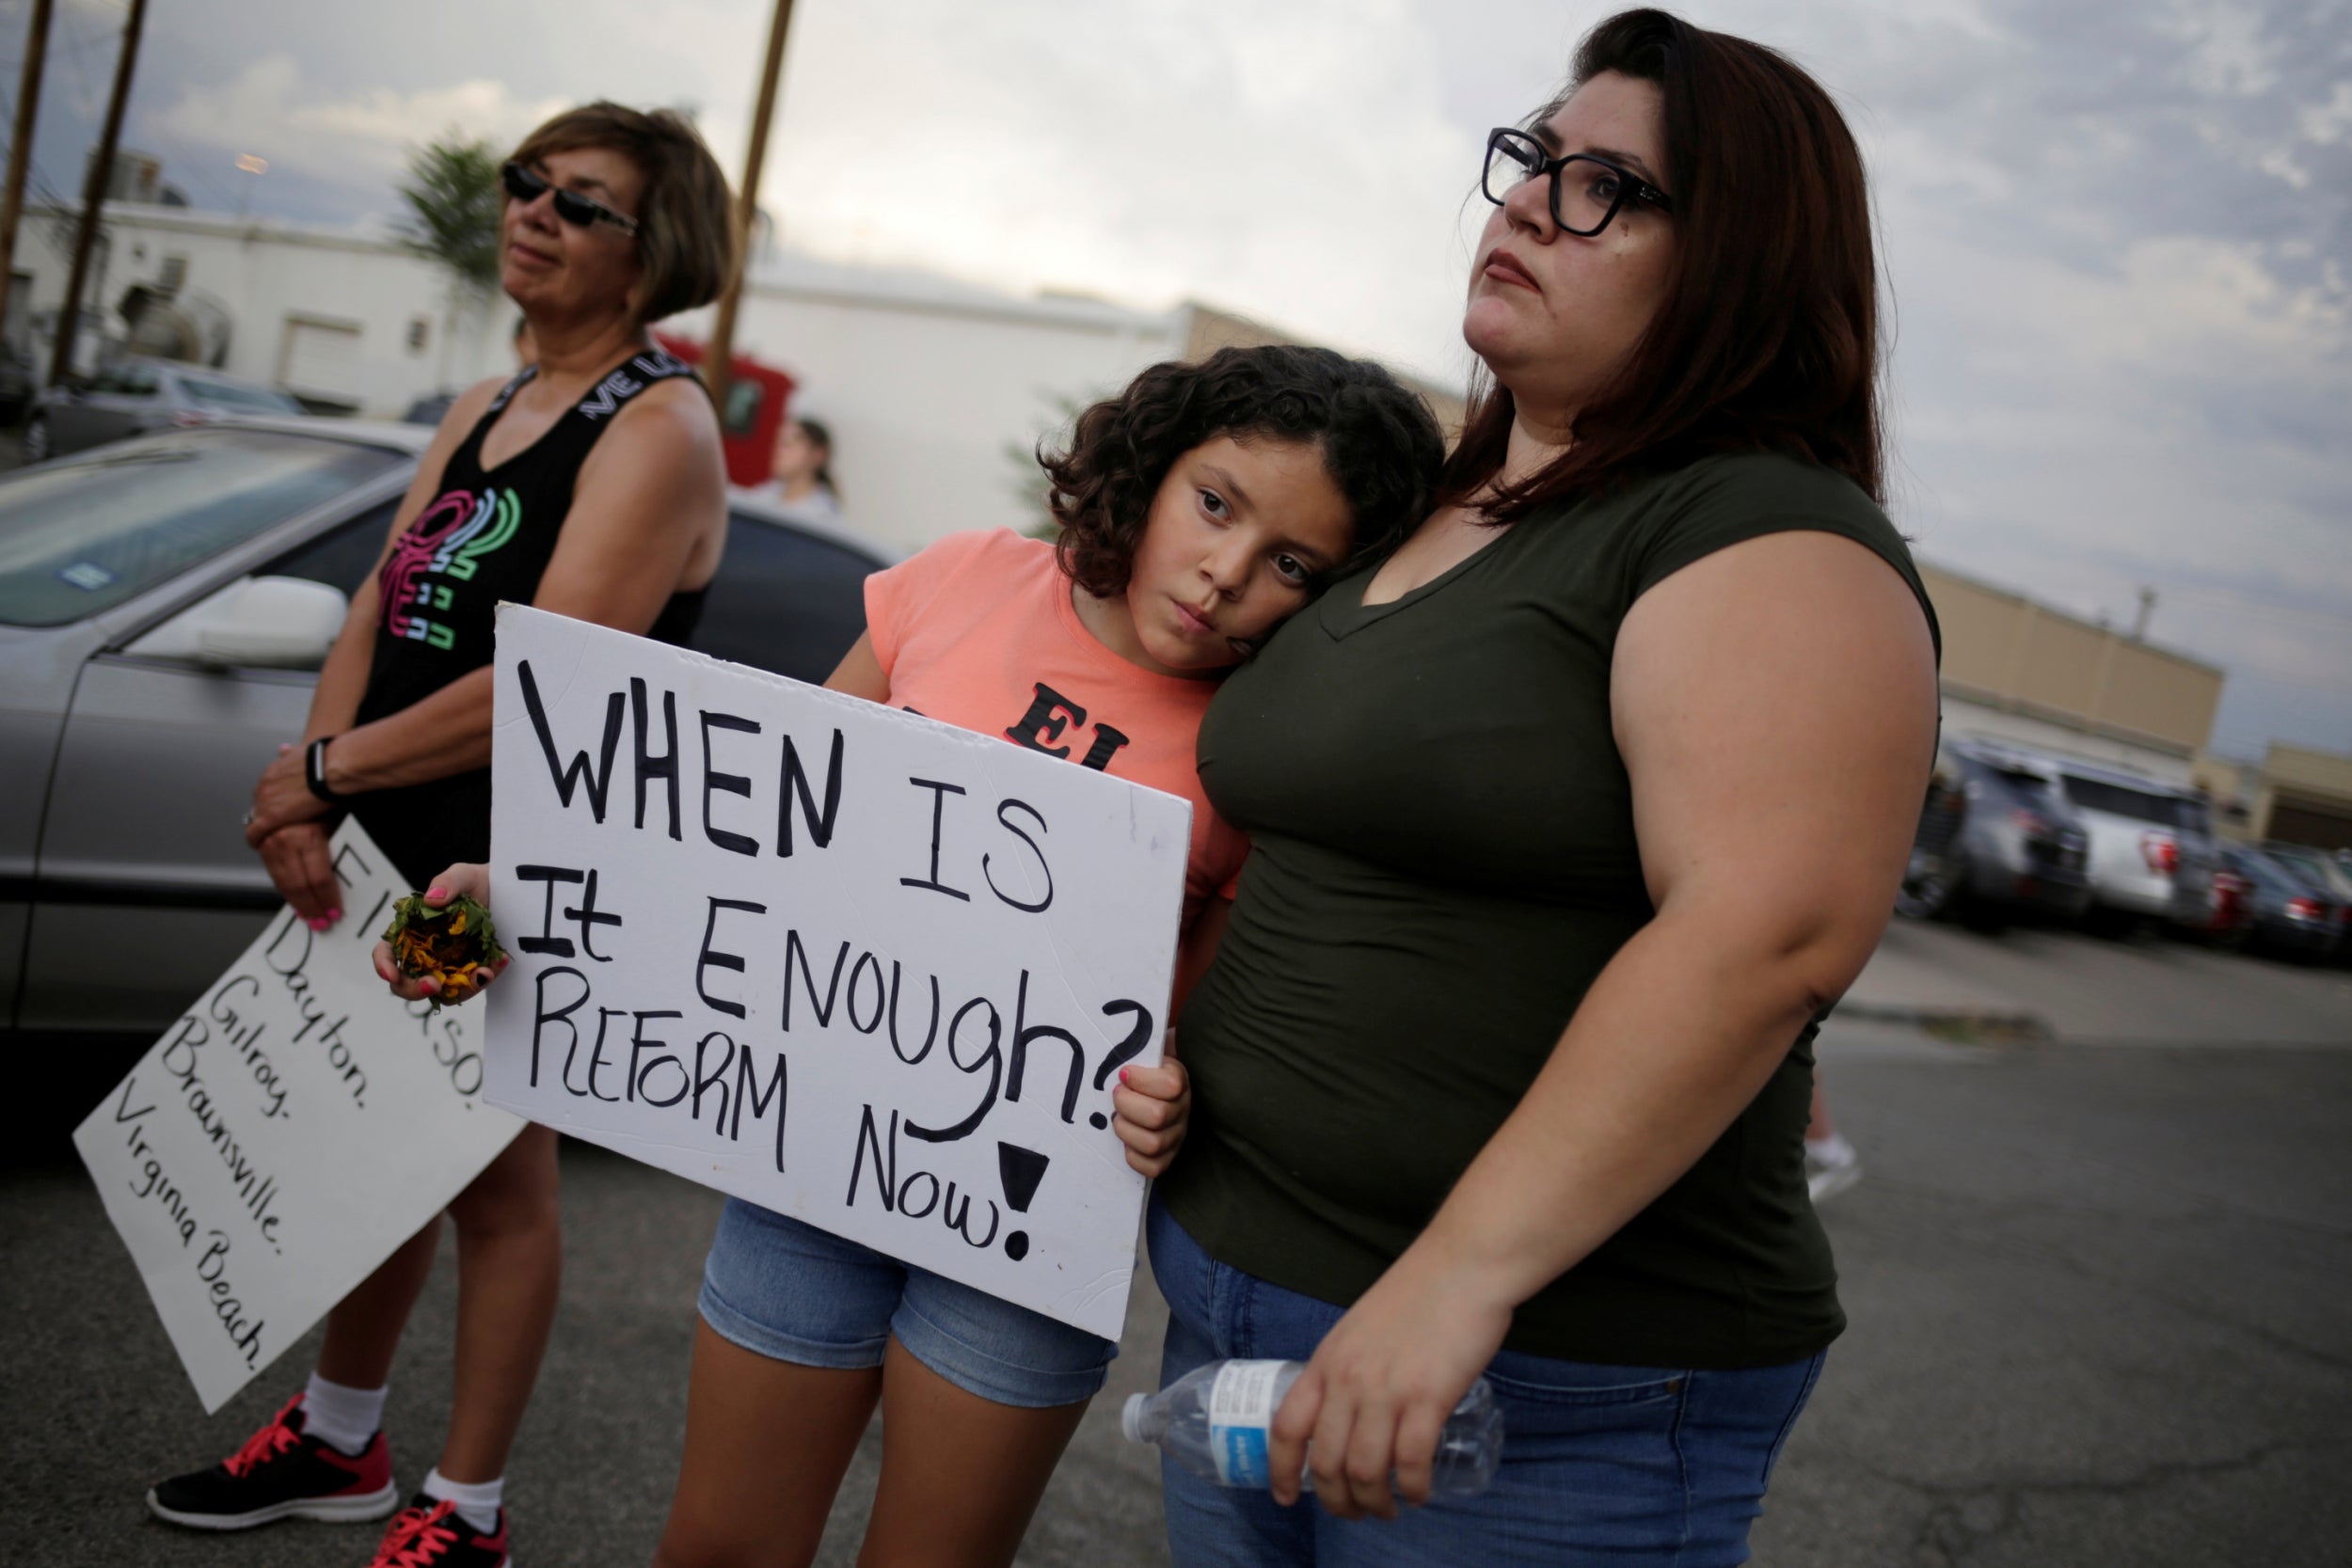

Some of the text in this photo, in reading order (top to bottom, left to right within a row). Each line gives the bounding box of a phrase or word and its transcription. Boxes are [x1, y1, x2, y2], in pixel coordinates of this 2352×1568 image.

[516, 658, 1054, 913] WHEN IS
[265, 913, 368, 1109] Dayton.
[515, 863, 623, 963] It
[161, 1013, 282, 1255] Brownsville.
[210, 974, 289, 1118] Gilroy.
[529, 965, 787, 1174] REFORM
[115, 1077, 265, 1371] Virginia Beach.
